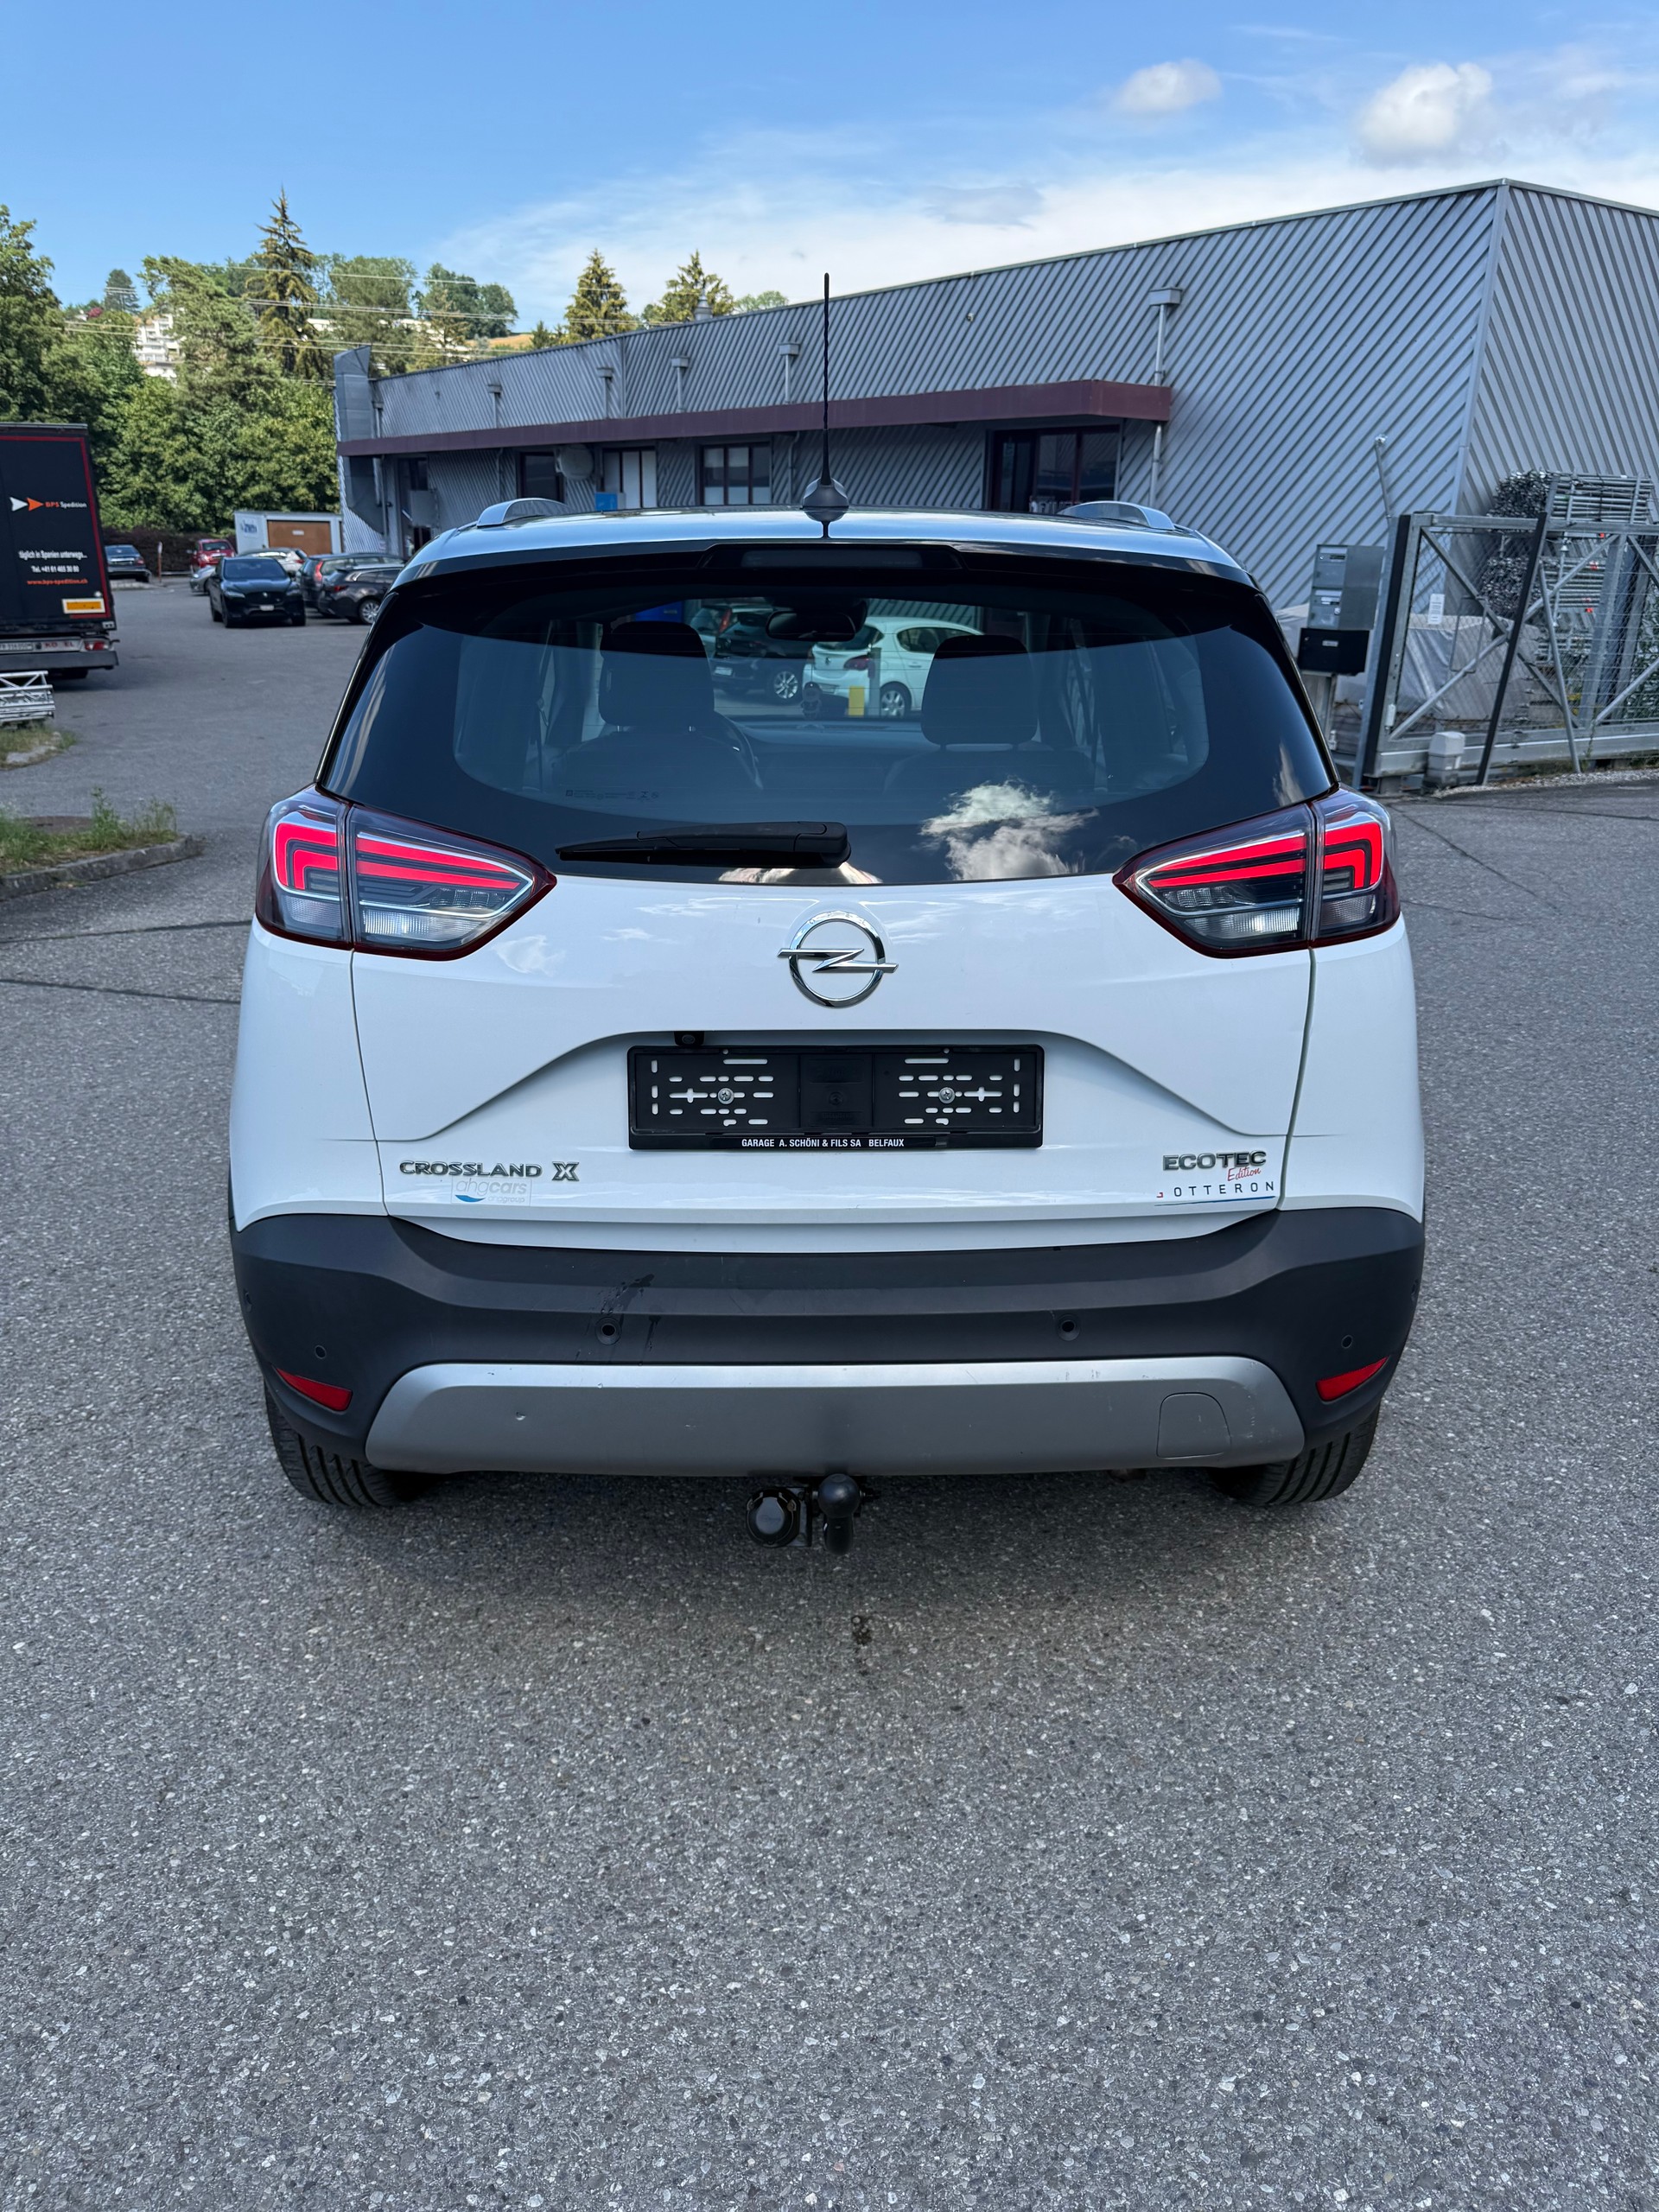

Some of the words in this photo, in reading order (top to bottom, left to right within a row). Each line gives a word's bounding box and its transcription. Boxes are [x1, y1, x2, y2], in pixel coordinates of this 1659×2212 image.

[60, 500, 87, 509] Spedition
[741, 1138, 775, 1147] GARAGE
[779, 1138, 787, 1147] A.
[789, 1137, 820, 1147] SCHÖNI
[822, 1138, 829, 1147] &
[830, 1138, 849, 1147] FILS
[850, 1138, 861, 1147] SA
[868, 1138, 905, 1147] BELFAUX
[1162, 1150, 1267, 1171] ECOTEC
[399, 1160, 543, 1178] CROSSLAND
[551, 1160, 580, 1181] X
[1227, 1166, 1262, 1182] Edition
[454, 1178, 527, 1196] ahgcars
